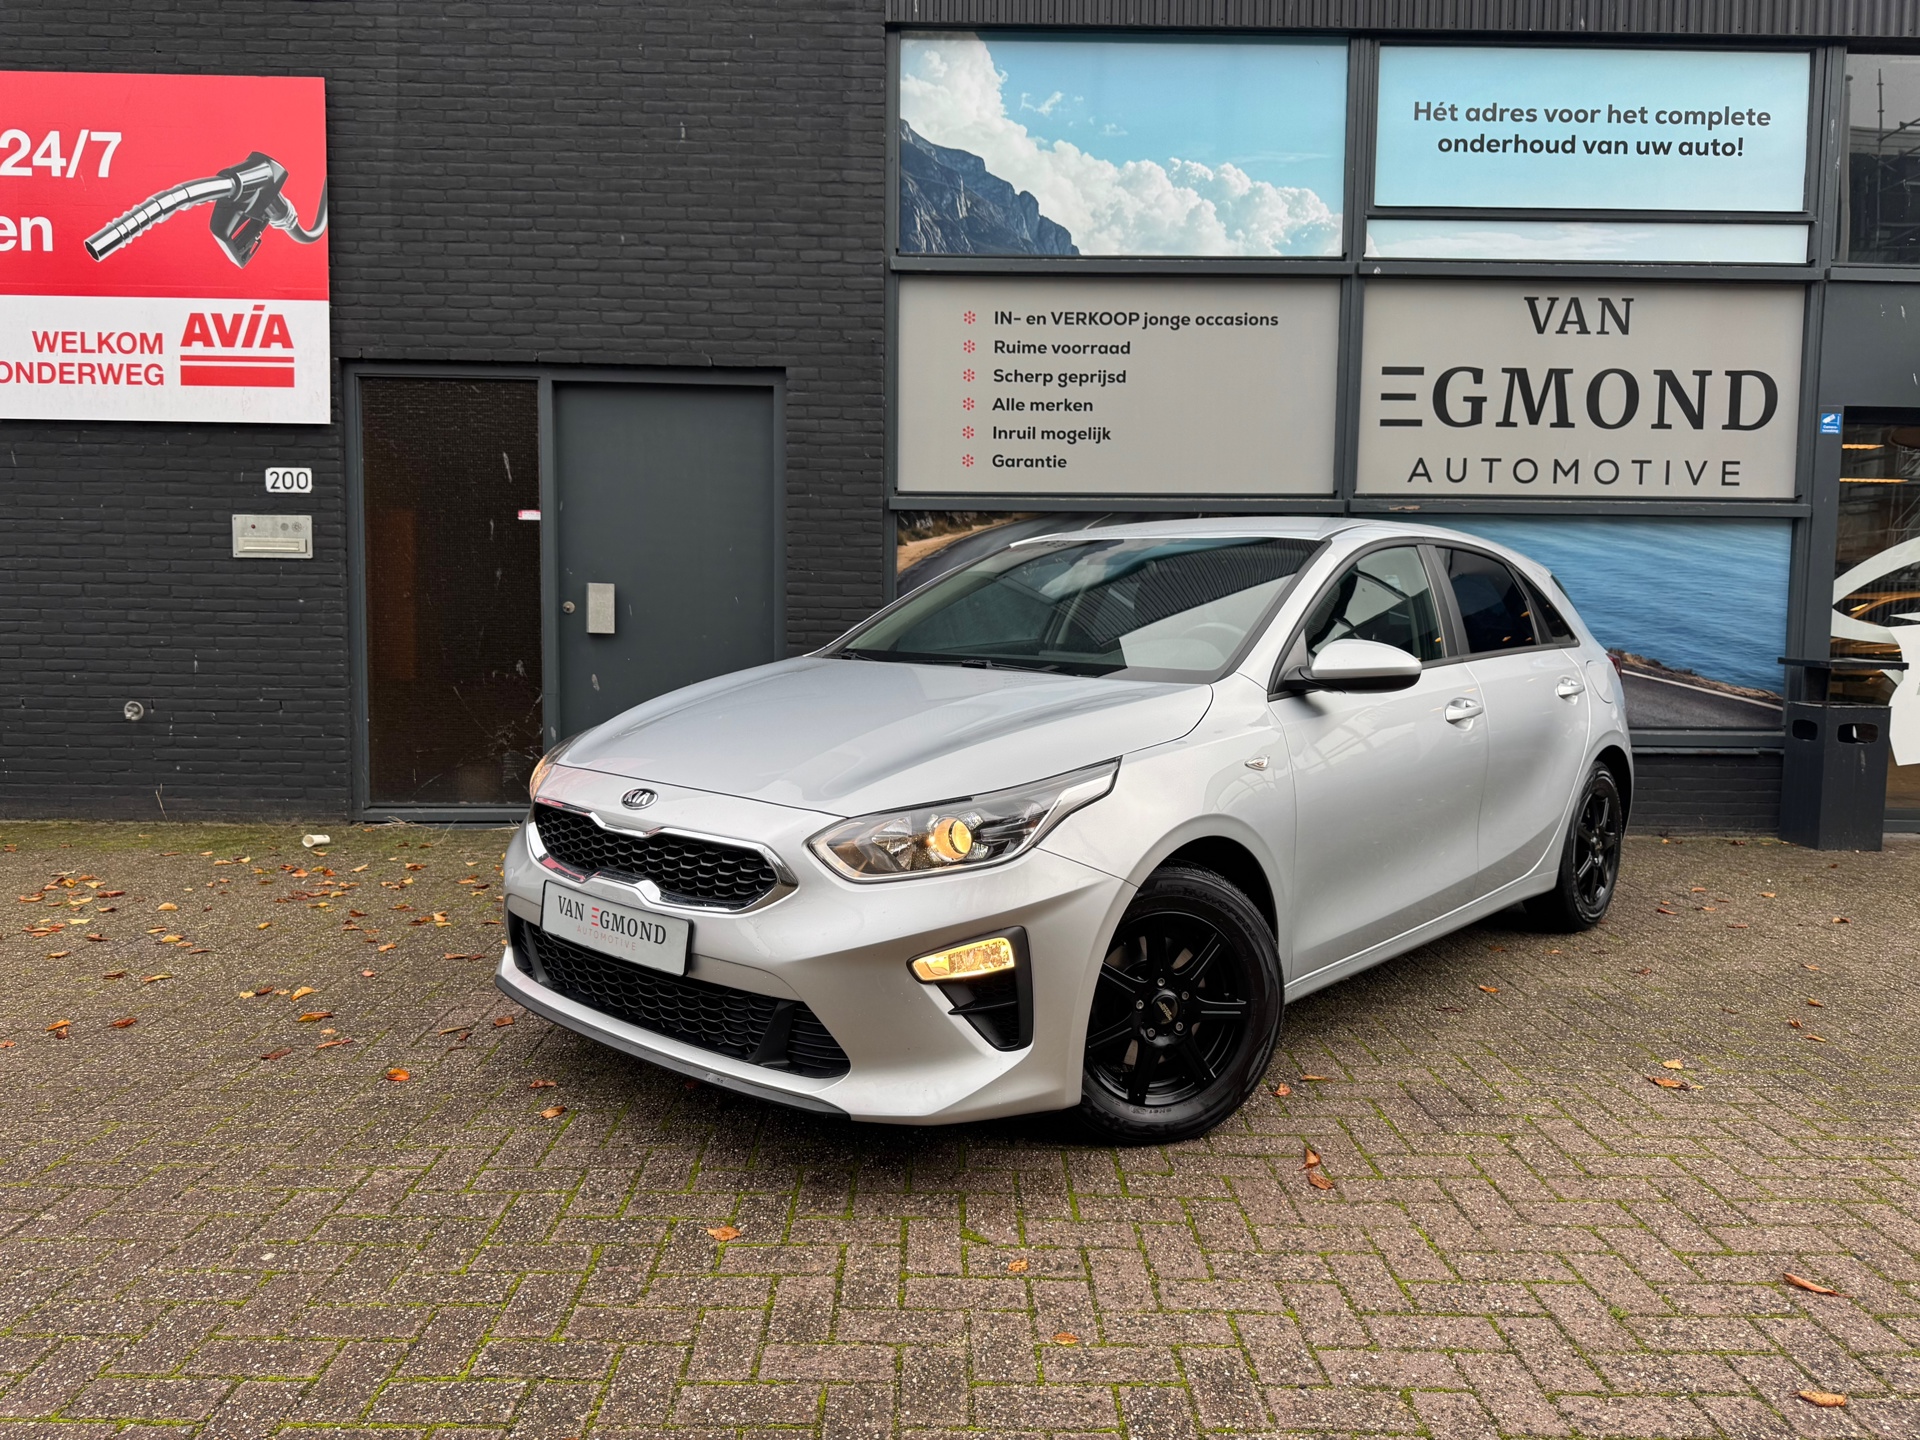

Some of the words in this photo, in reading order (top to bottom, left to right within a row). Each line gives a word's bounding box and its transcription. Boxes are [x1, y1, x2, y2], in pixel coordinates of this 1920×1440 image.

[1413, 101, 1459, 122] Hét
[1465, 102, 1538, 123] adres
[1543, 108, 1602, 124] voor
[1607, 104, 1649, 125] het
[1655, 105, 1771, 131] complete
[0, 128, 122, 178] 24/7
[1437, 133, 1576, 155] onderhoud
[1582, 140, 1629, 155] van
[1635, 140, 1673, 156] uw
[1678, 137, 1744, 157] auto!
[180, 304, 295, 349] AVIA
[994, 310, 1022, 325] IN-
[1025, 314, 1047, 326] en
[1050, 311, 1140, 326] VERKOOP
[1142, 312, 1191, 331] jonge
[1195, 312, 1279, 327] occasions
[1523, 296, 1635, 335] VAN
[32, 331, 164, 355] WELKOM
[994, 340, 1048, 355] Ruime
[1051, 340, 1131, 355] voorraad
[0, 361, 165, 387] ONDERWEG
[993, 368, 1054, 387] Scherp
[1057, 369, 1127, 388] geprijsd
[992, 397, 1026, 412] Alle
[1030, 398, 1094, 412] merken
[1379, 366, 1779, 431] EGMOND
[992, 425, 1036, 440] Inruil
[1040, 426, 1112, 445] mogelijk
[992, 453, 1068, 469] Garantie
[1407, 457, 1742, 487] AUTOMOTIVE
[269, 471, 309, 490] 200
[624, 790, 650, 805] KIA
[558, 896, 584, 921] VAN
[591, 907, 667, 945] EGMOND
[577, 925, 637, 951] AUTOMOTIVE
